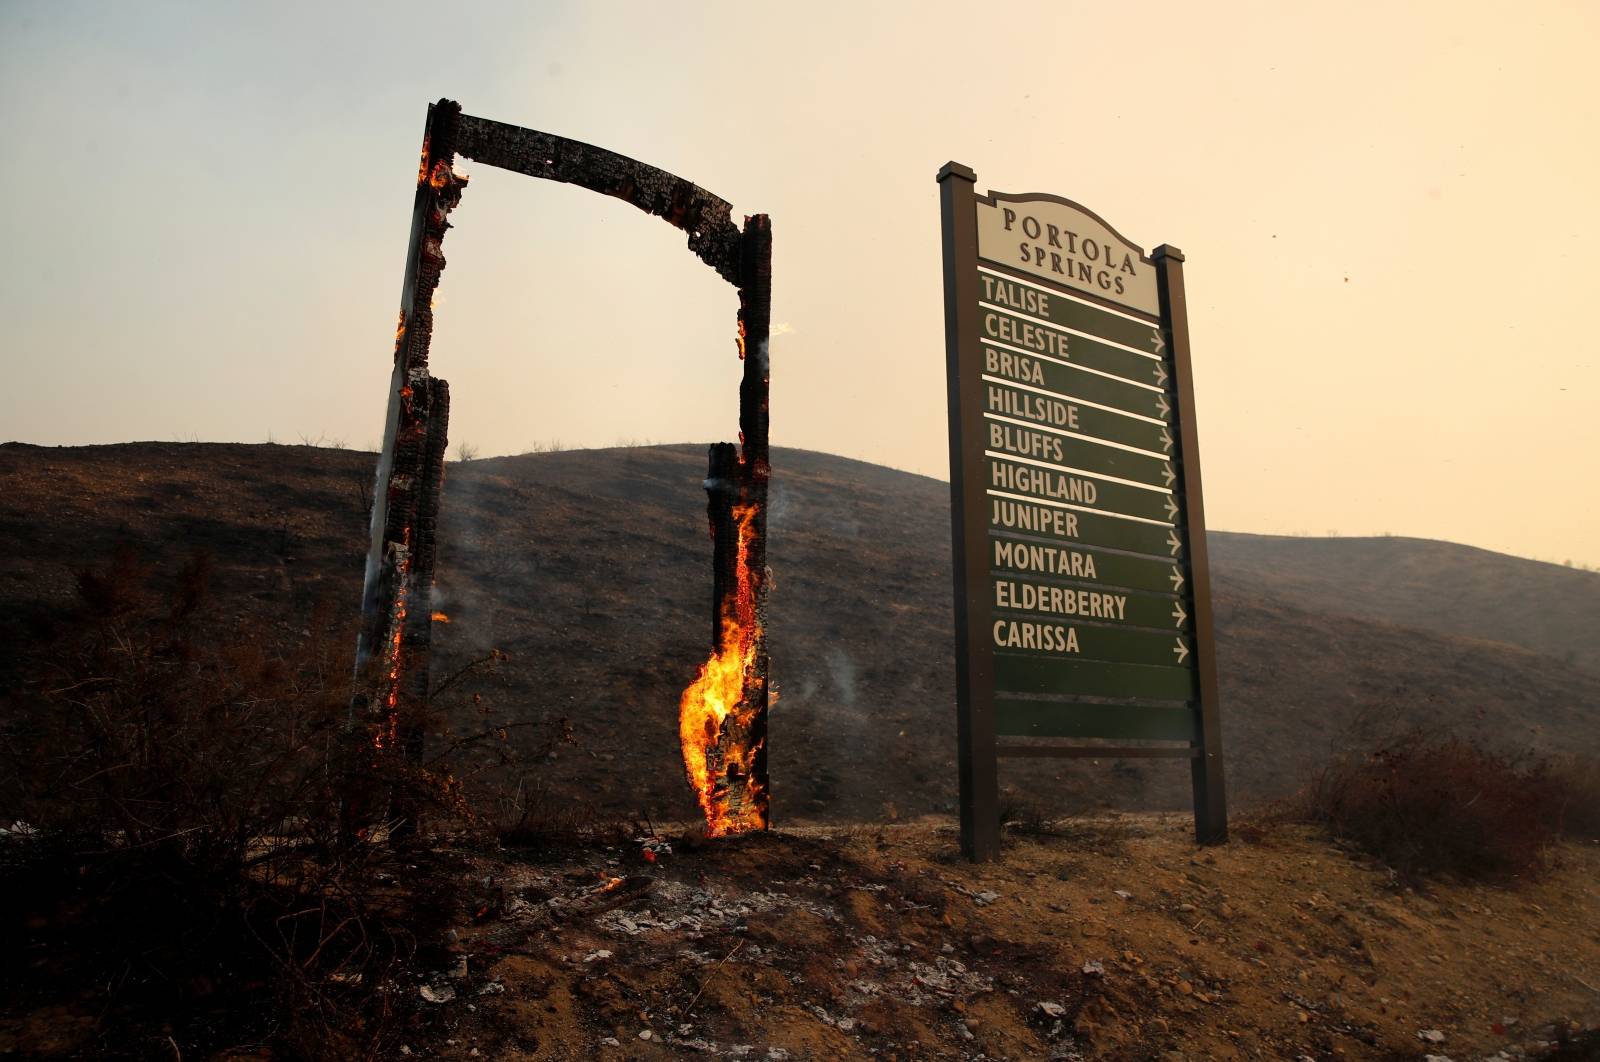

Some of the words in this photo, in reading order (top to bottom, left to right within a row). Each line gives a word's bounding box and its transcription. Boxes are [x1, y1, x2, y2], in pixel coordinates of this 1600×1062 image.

[1003, 207, 1137, 276] PORTOLA
[1020, 242, 1125, 295] SPRINGS
[982, 275, 1050, 317] TALISE
[985, 313, 1069, 358] CELESTE
[985, 348, 1045, 385] BRISA
[988, 386, 1080, 429] HILLSIDE
[990, 423, 1063, 462] BLUFFS
[992, 461, 1097, 505] HIGHLAND
[992, 500, 1079, 538] JUNIPER
[995, 540, 1097, 579] MONTARA
[996, 581, 1126, 620] ELDERBERRY
[993, 620, 1080, 652] CARISSA
